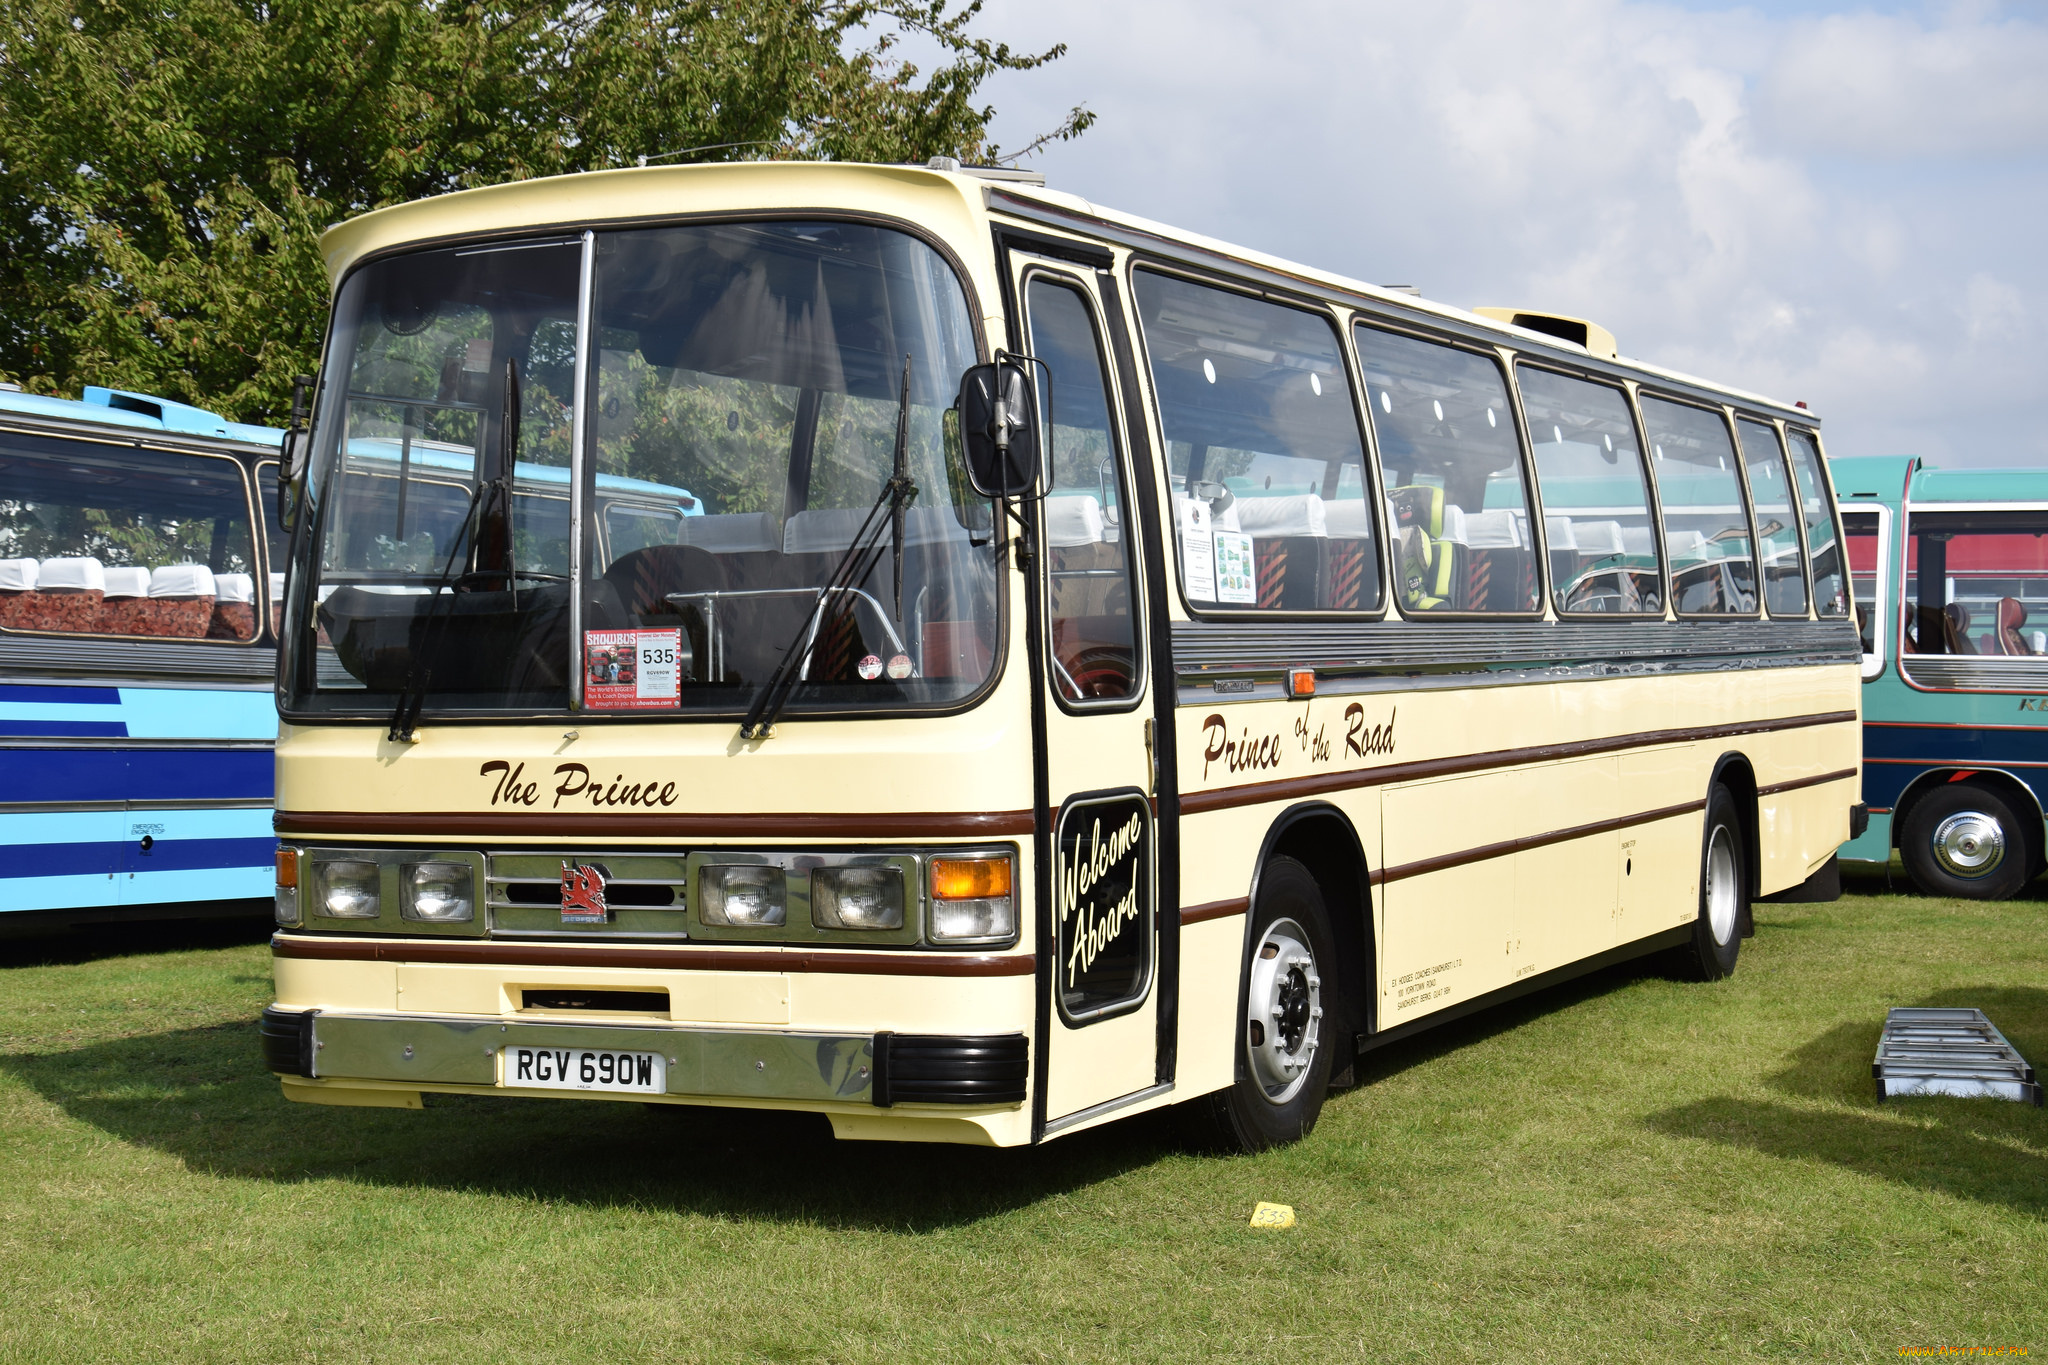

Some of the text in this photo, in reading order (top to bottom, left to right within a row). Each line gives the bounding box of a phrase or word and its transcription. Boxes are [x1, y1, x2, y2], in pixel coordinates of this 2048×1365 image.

[587, 633, 636, 645] SHOWBUS
[643, 649, 674, 664] 535
[1202, 700, 1396, 781] Prince of the Road
[480, 760, 679, 809] The Prince
[1061, 811, 1141, 921] Welcome
[1068, 857, 1138, 988] Aboard
[517, 1049, 653, 1086] RGV 690W
[1257, 1208, 1287, 1224] 535
